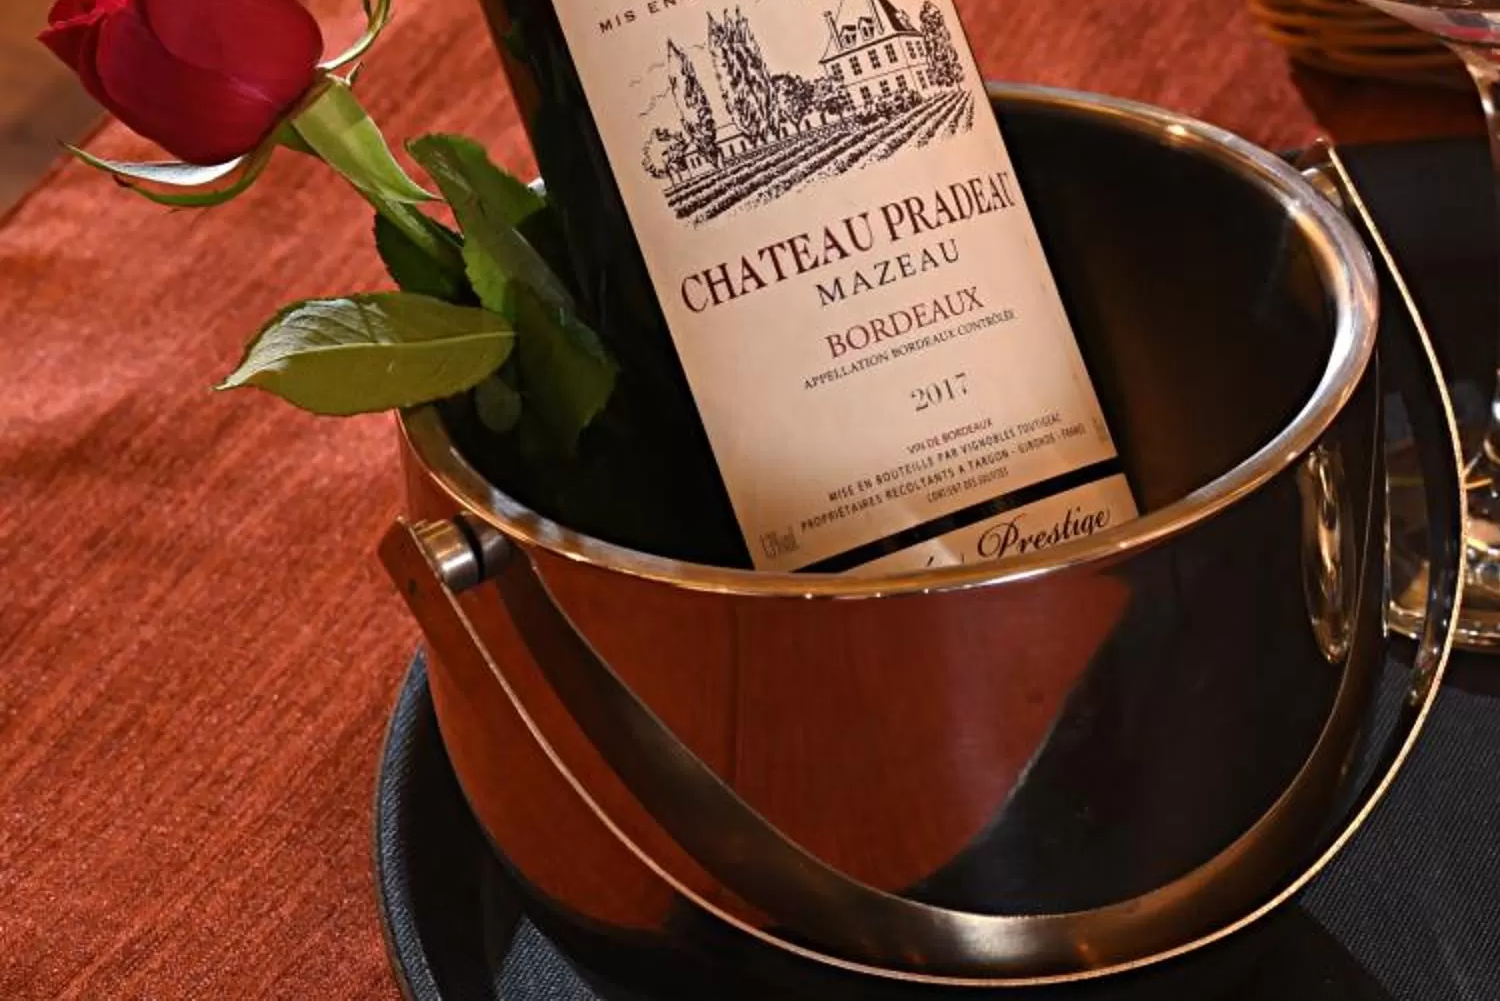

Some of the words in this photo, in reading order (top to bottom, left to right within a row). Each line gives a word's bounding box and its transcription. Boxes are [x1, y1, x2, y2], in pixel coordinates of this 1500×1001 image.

[599, 9, 636, 34] MIS
[680, 212, 874, 315] CHATEAU
[815, 238, 960, 308] MAZEAU
[824, 285, 985, 360] BORDEAUX
[802, 350, 890, 391] APPELLATION
[891, 329, 956, 360] BORDEAUX
[910, 371, 969, 412] 2017
[828, 485, 855, 502] MISE
[857, 479, 874, 492] EN
[874, 456, 934, 486] BOUTEILLE
[937, 447, 959, 462] PAR
[960, 428, 1016, 456] VIGNOBLES
[907, 442, 926, 455] VIN
[926, 436, 940, 449] DE
[940, 417, 993, 443] BORDEAUX
[966, 449, 1010, 471] TARGON
[976, 505, 1112, 559] Prestige
